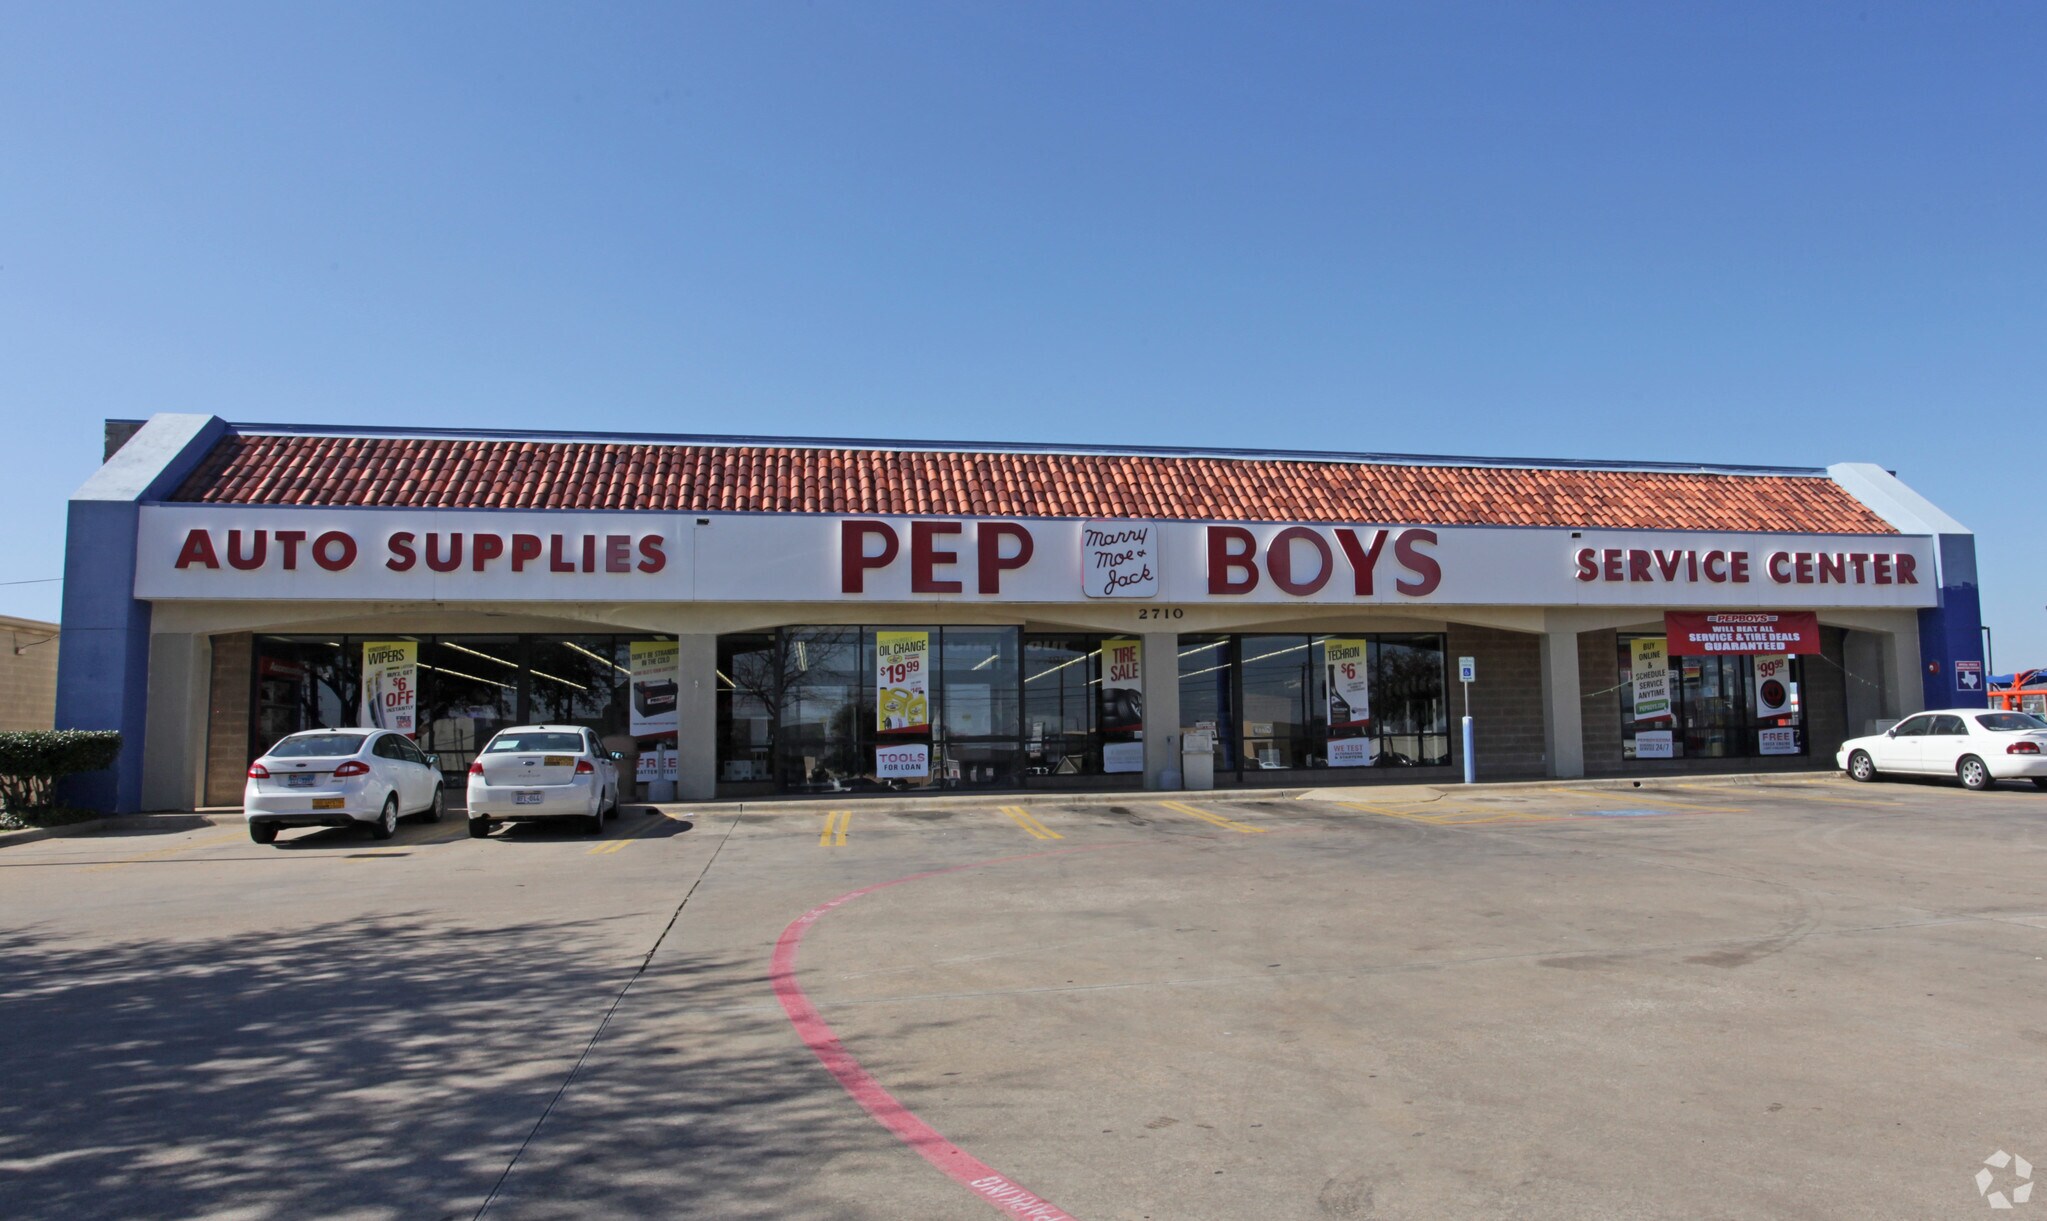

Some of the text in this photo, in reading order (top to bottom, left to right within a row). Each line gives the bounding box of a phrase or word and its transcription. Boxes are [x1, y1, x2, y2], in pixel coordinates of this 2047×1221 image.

[175, 528, 667, 574] AUTO SUPPLIES
[841, 519, 1442, 598] PEP BOYS
[1095, 550, 1134, 569] Moe
[1575, 548, 1919, 586] SERVICE CENTER
[1104, 564, 1154, 595] Jack
[1138, 608, 1184, 620] 2710
[1716, 614, 1768, 622] PEPBOYS
[1689, 633, 1732, 641] SERVICE
[1744, 633, 1767, 641] TIRE
[1769, 632, 1800, 641] DEALS
[879, 640, 926, 656] OIL CHANGE
[1643, 642, 1655, 650] BUY
[1704, 642, 1786, 651] GUARANTEED
[368, 649, 404, 665] WIPERS
[1112, 646, 1136, 664] TIRE
[1328, 647, 1360, 661] TECHRON
[1639, 651, 1660, 661] ONLINE
[1111, 662, 1139, 682] SALE
[1636, 669, 1666, 681] SCHEDULE
[393, 678, 406, 691] $6
[1639, 679, 1663, 690] SERVICE
[386, 690, 414, 707] OFF
[1638, 688, 1665, 700] ANYTIME
[1762, 733, 1790, 741] FREE
[879, 753, 926, 763] TOOLS
